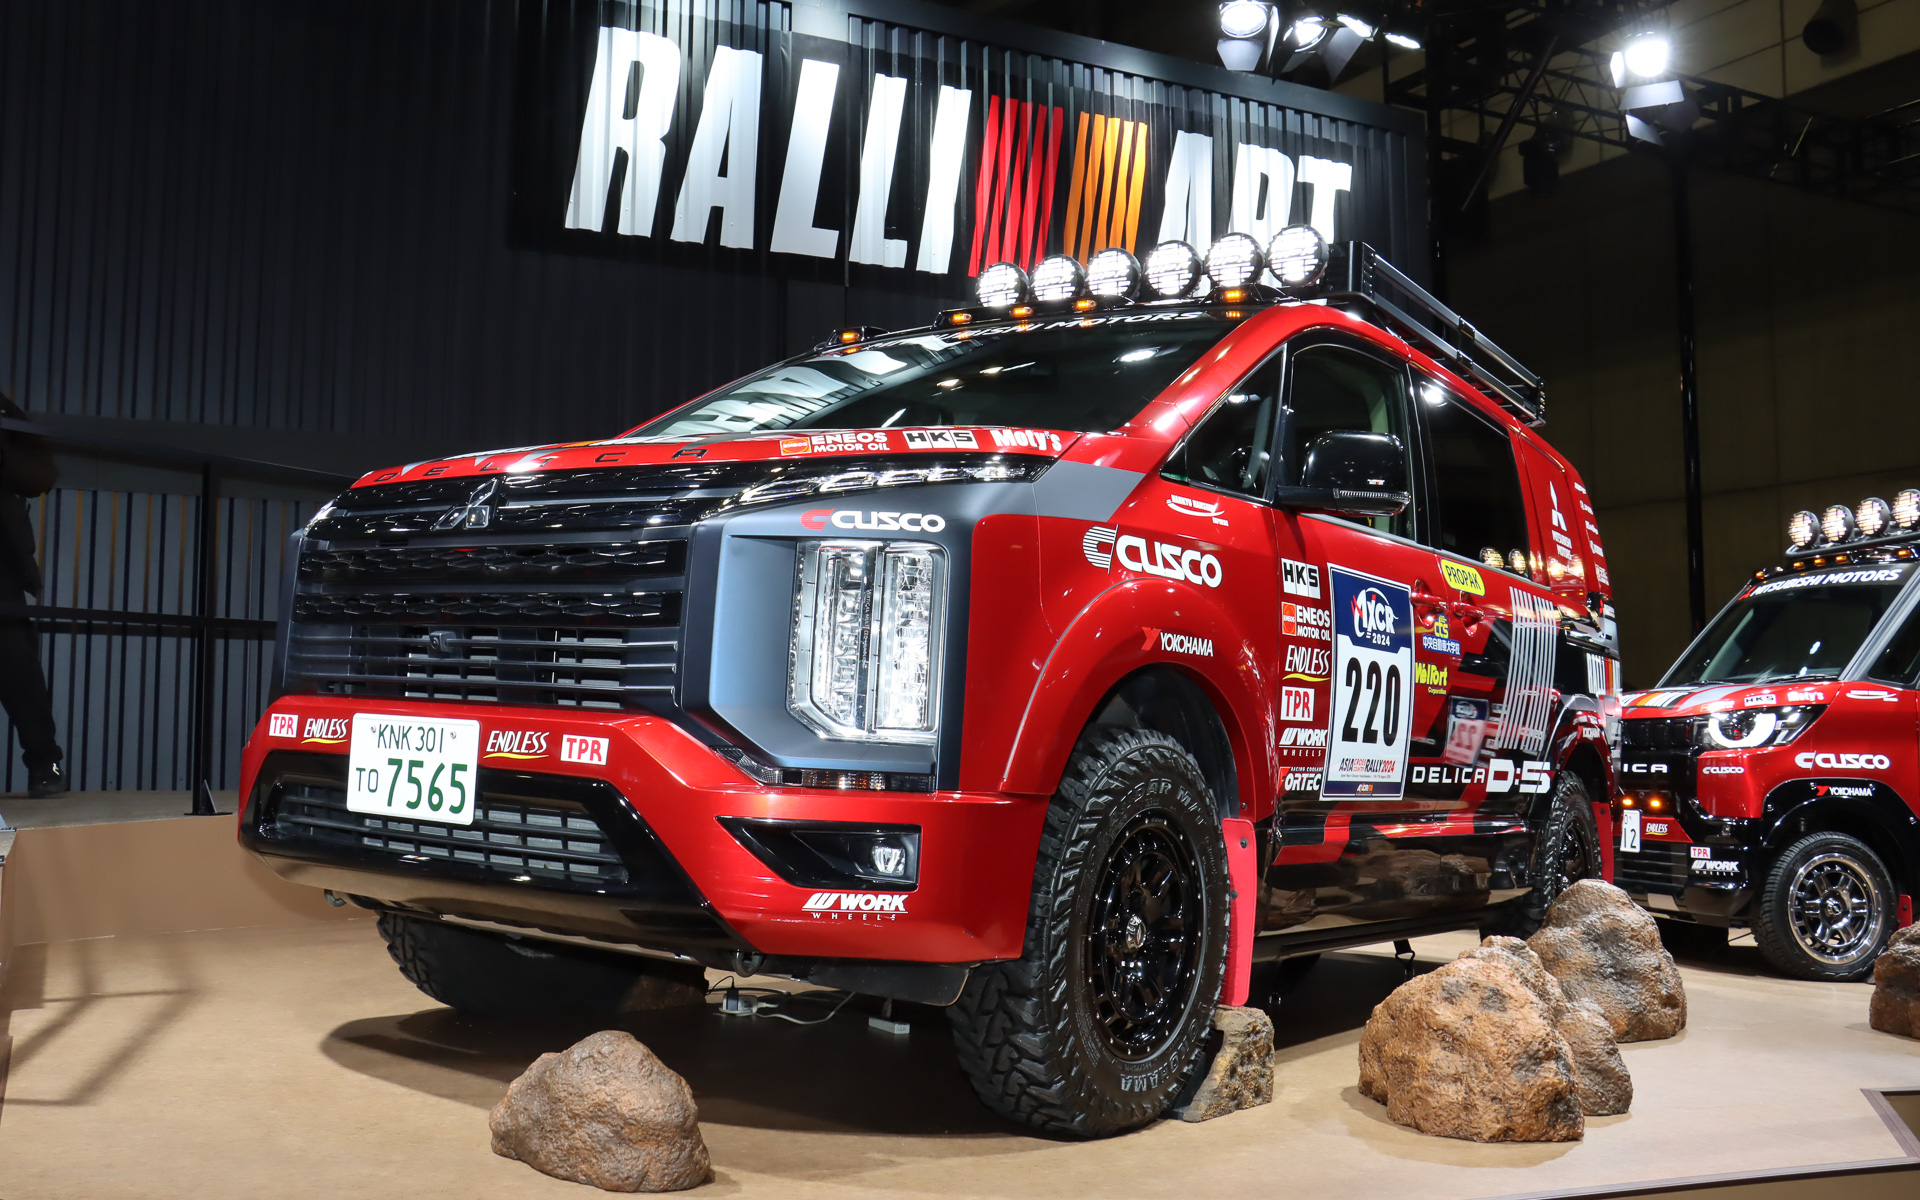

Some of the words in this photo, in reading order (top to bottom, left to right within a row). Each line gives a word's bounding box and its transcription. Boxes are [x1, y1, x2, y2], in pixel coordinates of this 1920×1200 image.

[1044, 312, 1202, 330] MOTORS
[811, 431, 888, 444] ENEOS
[814, 442, 863, 453] MOTOR
[865, 440, 890, 452] OIL
[904, 430, 976, 445] HKS
[990, 428, 1062, 451] Moty's
[373, 448, 708, 484] DELICA
[831, 511, 946, 533] CUSCO
[1116, 535, 1223, 588] CUSCO
[1283, 562, 1319, 588] HKS
[1446, 565, 1482, 590] PROPAK
[1750, 574, 1825, 597] MITSUBISHI
[1822, 569, 1903, 585] MOTORS
[1297, 605, 1331, 628] ENEOS
[1297, 625, 1320, 640] MOTOR
[1321, 629, 1331, 641] OIL
[1372, 633, 1391, 646] 2024
[1160, 632, 1214, 657] YOKOHAMA
[1285, 644, 1331, 675] ENDLESS
[1285, 690, 1311, 718] TPR
[1342, 656, 1401, 747] 220
[1745, 695, 1775, 704] HKS
[273, 715, 294, 736] TPR
[303, 718, 349, 740] ENDLESS
[377, 723, 412, 751] KNK
[417, 726, 444, 753] 301
[486, 730, 549, 754] ENDLESS
[1297, 728, 1328, 746] WORK
[567, 734, 602, 763] TPR
[1283, 749, 1322, 757] WHEELS
[1710, 766, 1745, 774] CUSCO
[1815, 752, 1891, 770] CUSCO
[1412, 766, 1486, 784] DELICA
[355, 767, 379, 794] TO
[387, 757, 468, 815] 7565
[1829, 786, 1873, 797] YOKOHAMA
[1645, 822, 1669, 834] ENDLESS
[1692, 847, 1709, 858] TPR
[1706, 860, 1740, 871] WORK
[839, 894, 909, 911] WORK
[811, 912, 897, 921] WHEELS
